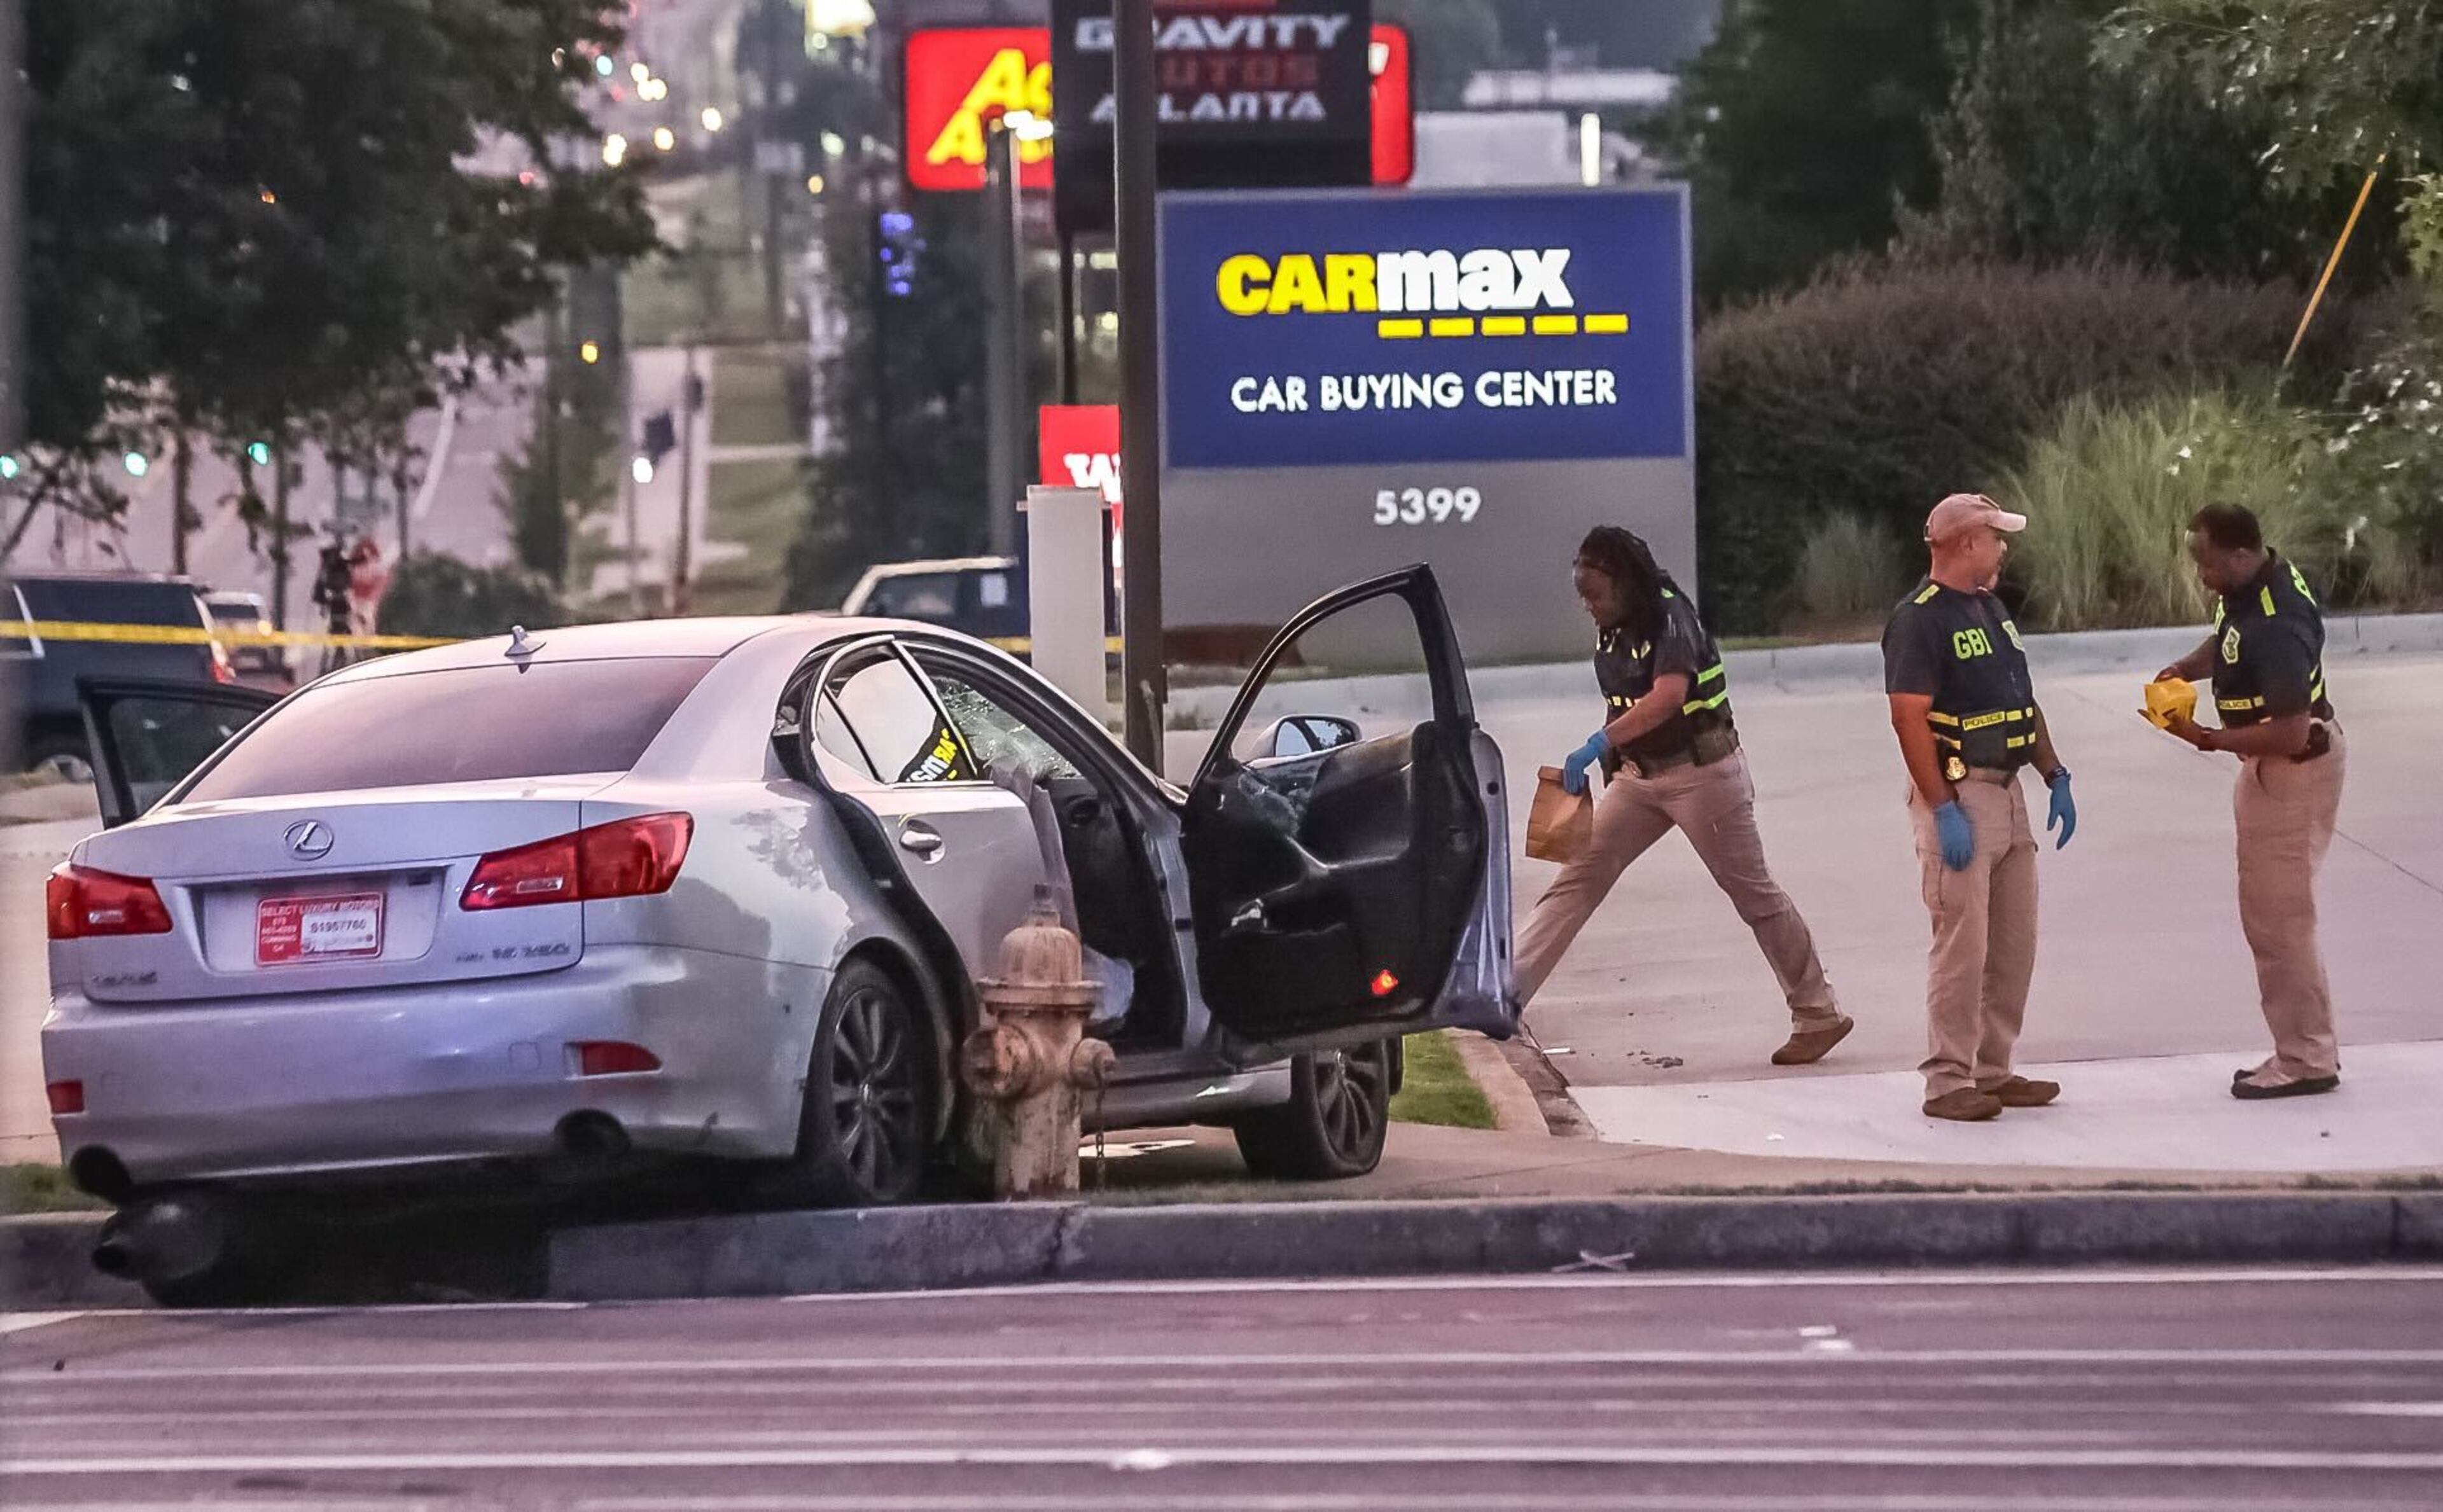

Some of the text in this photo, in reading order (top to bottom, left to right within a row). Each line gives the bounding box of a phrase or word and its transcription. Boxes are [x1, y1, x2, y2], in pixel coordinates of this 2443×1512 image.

[1075, 15, 1351, 50] GAVITY
[1162, 55, 1319, 87] UTOS
[1090, 91, 1326, 122] ALANTA
[1230, 369, 1618, 413] CAR BUYING CENTER
[1374, 486, 1482, 525] 5399
[1952, 627, 1993, 660] GBI
[1963, 713, 2004, 730] POLICE
[260, 899, 379, 917] SELECT LUXURY MOTORS
